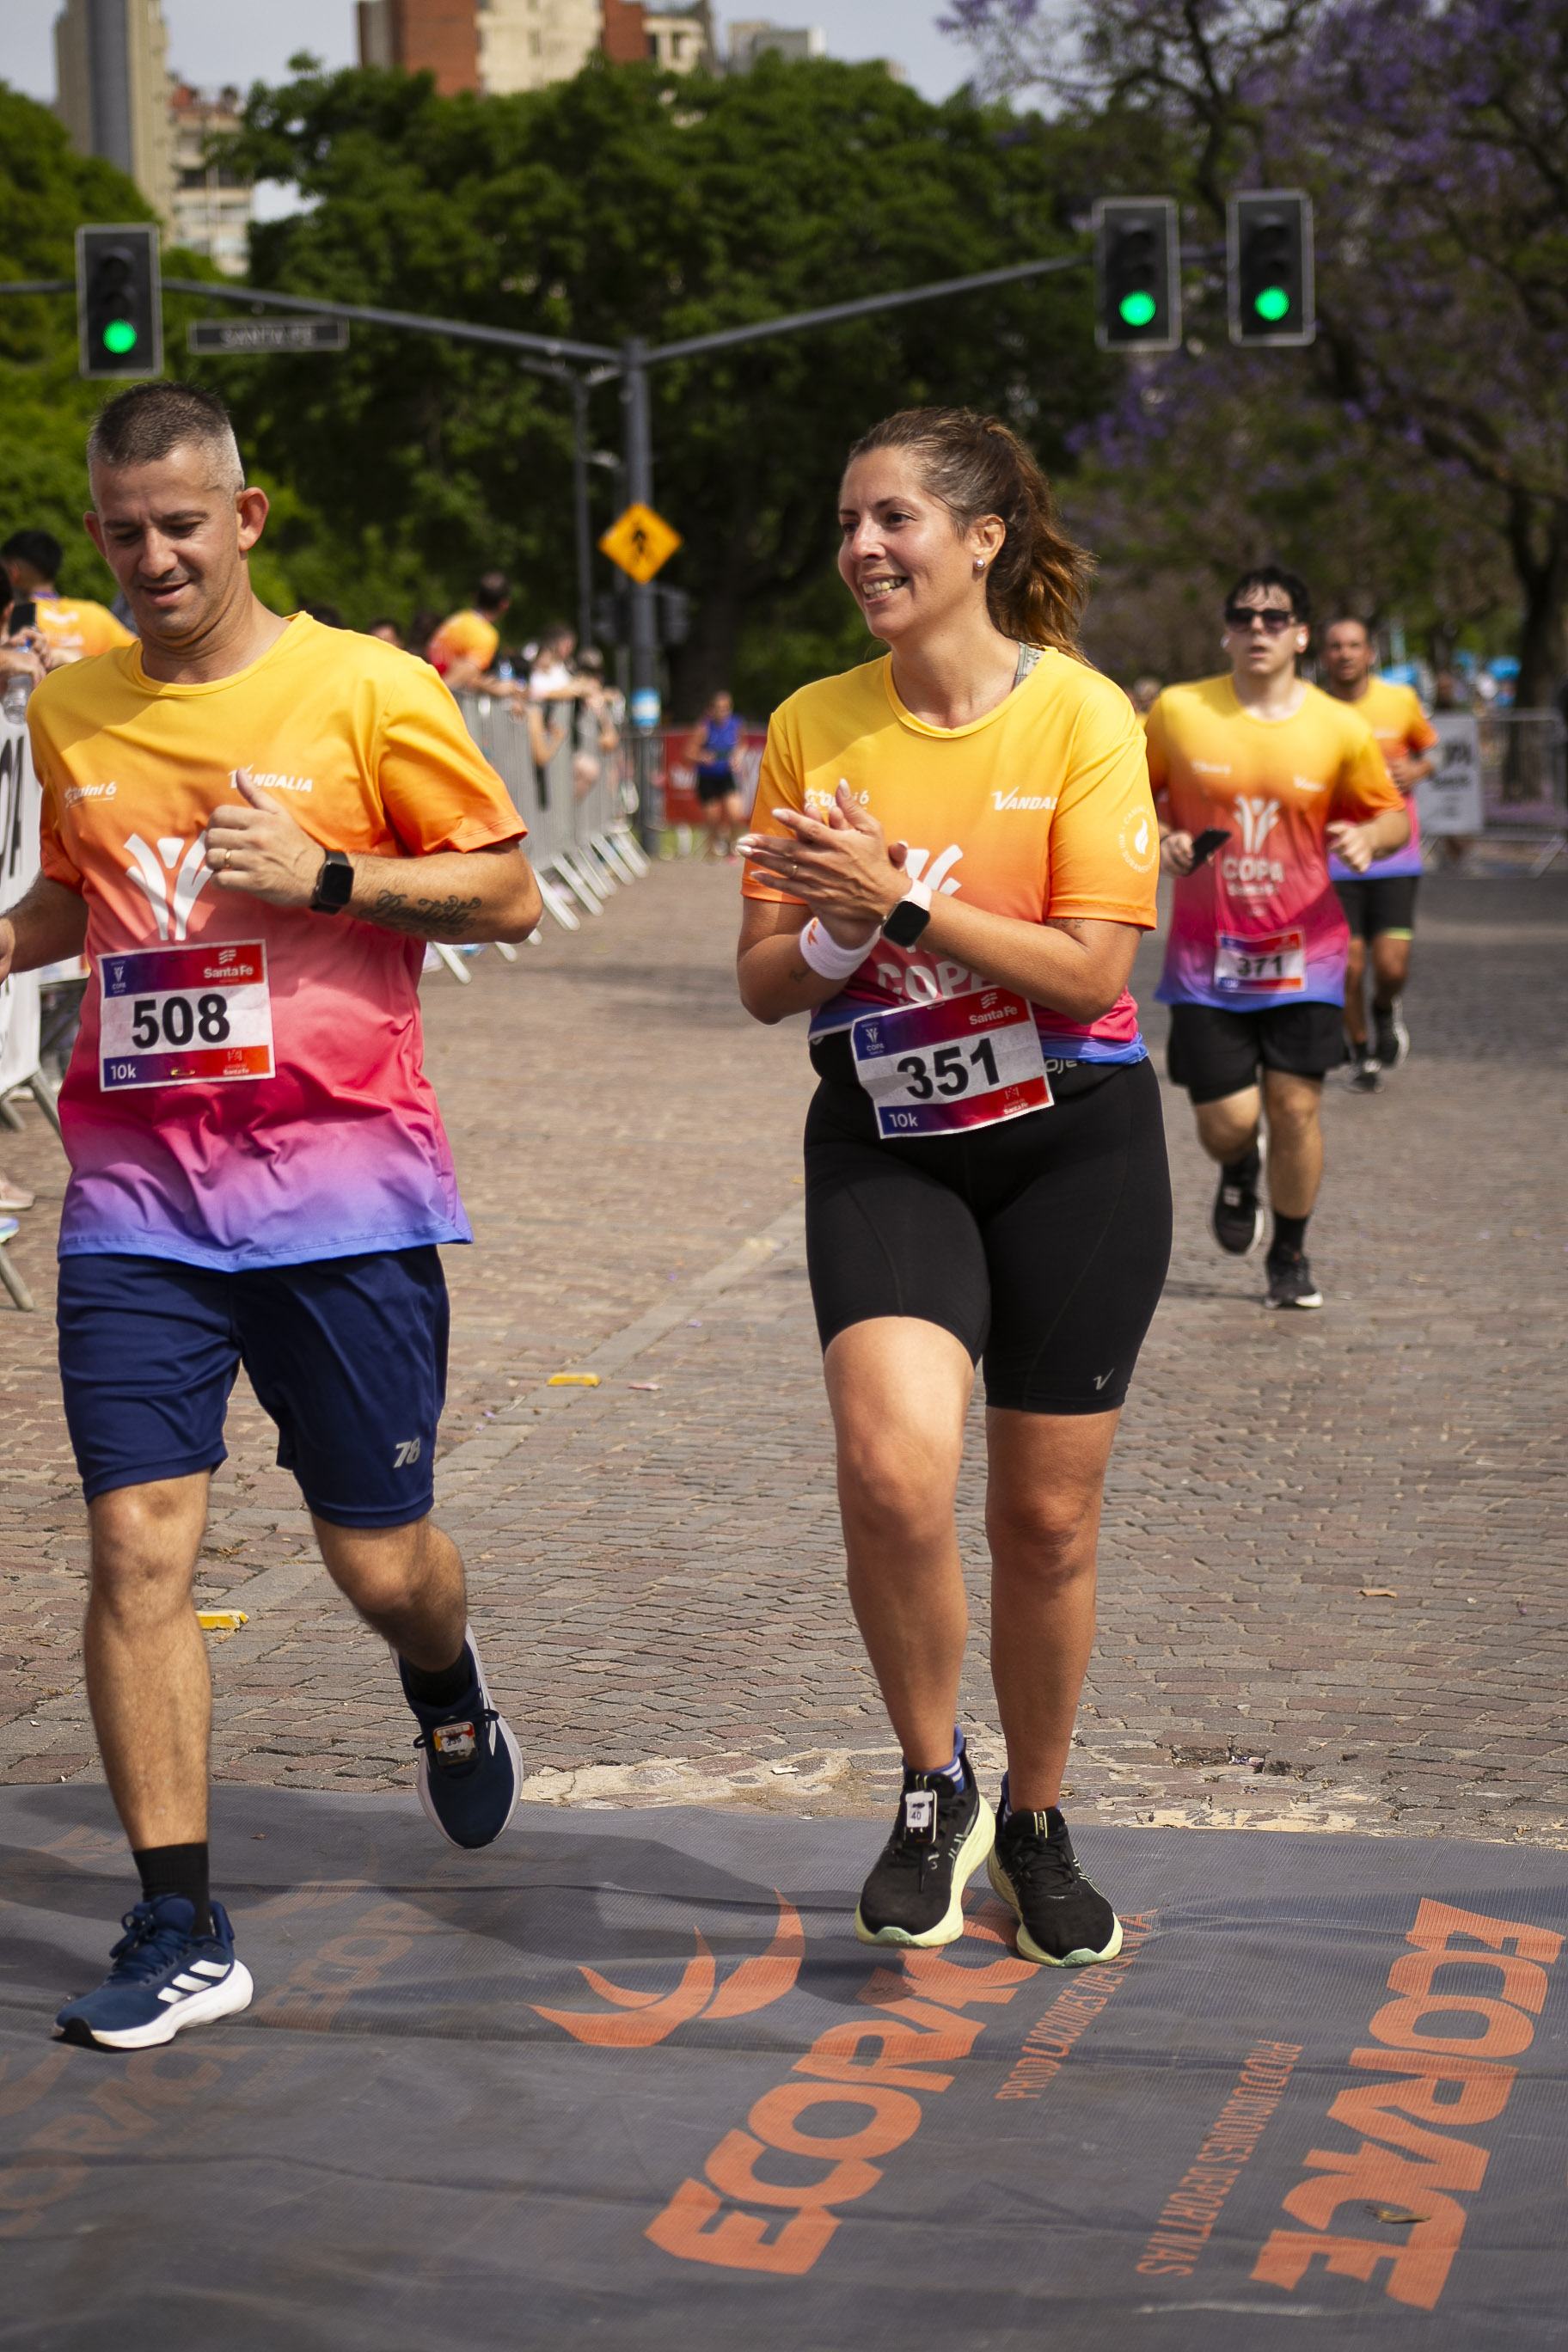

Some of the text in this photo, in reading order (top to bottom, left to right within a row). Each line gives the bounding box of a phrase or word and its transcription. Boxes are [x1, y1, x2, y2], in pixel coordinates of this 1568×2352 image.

[105, 781, 117, 796] 6
[860, 790, 870, 805] 6
[991, 786, 1058, 811] VANDAL
[1222, 856, 1284, 883] COPA
[204, 964, 254, 979] Santa Fe
[1238, 955, 1283, 977] 371
[132, 994, 230, 1049] 508
[969, 1009, 1005, 1026] Santa
[1004, 1005, 1018, 1017] Fe
[111, 1064, 137, 1080] 10k
[897, 1038, 1000, 1099] 351
[889, 1112, 918, 1128] 10k
[1248, 1897, 1567, 2311] ECORACE
[1136, 2040, 1303, 2276] PRODUCCIONES DEPORTIVAS
